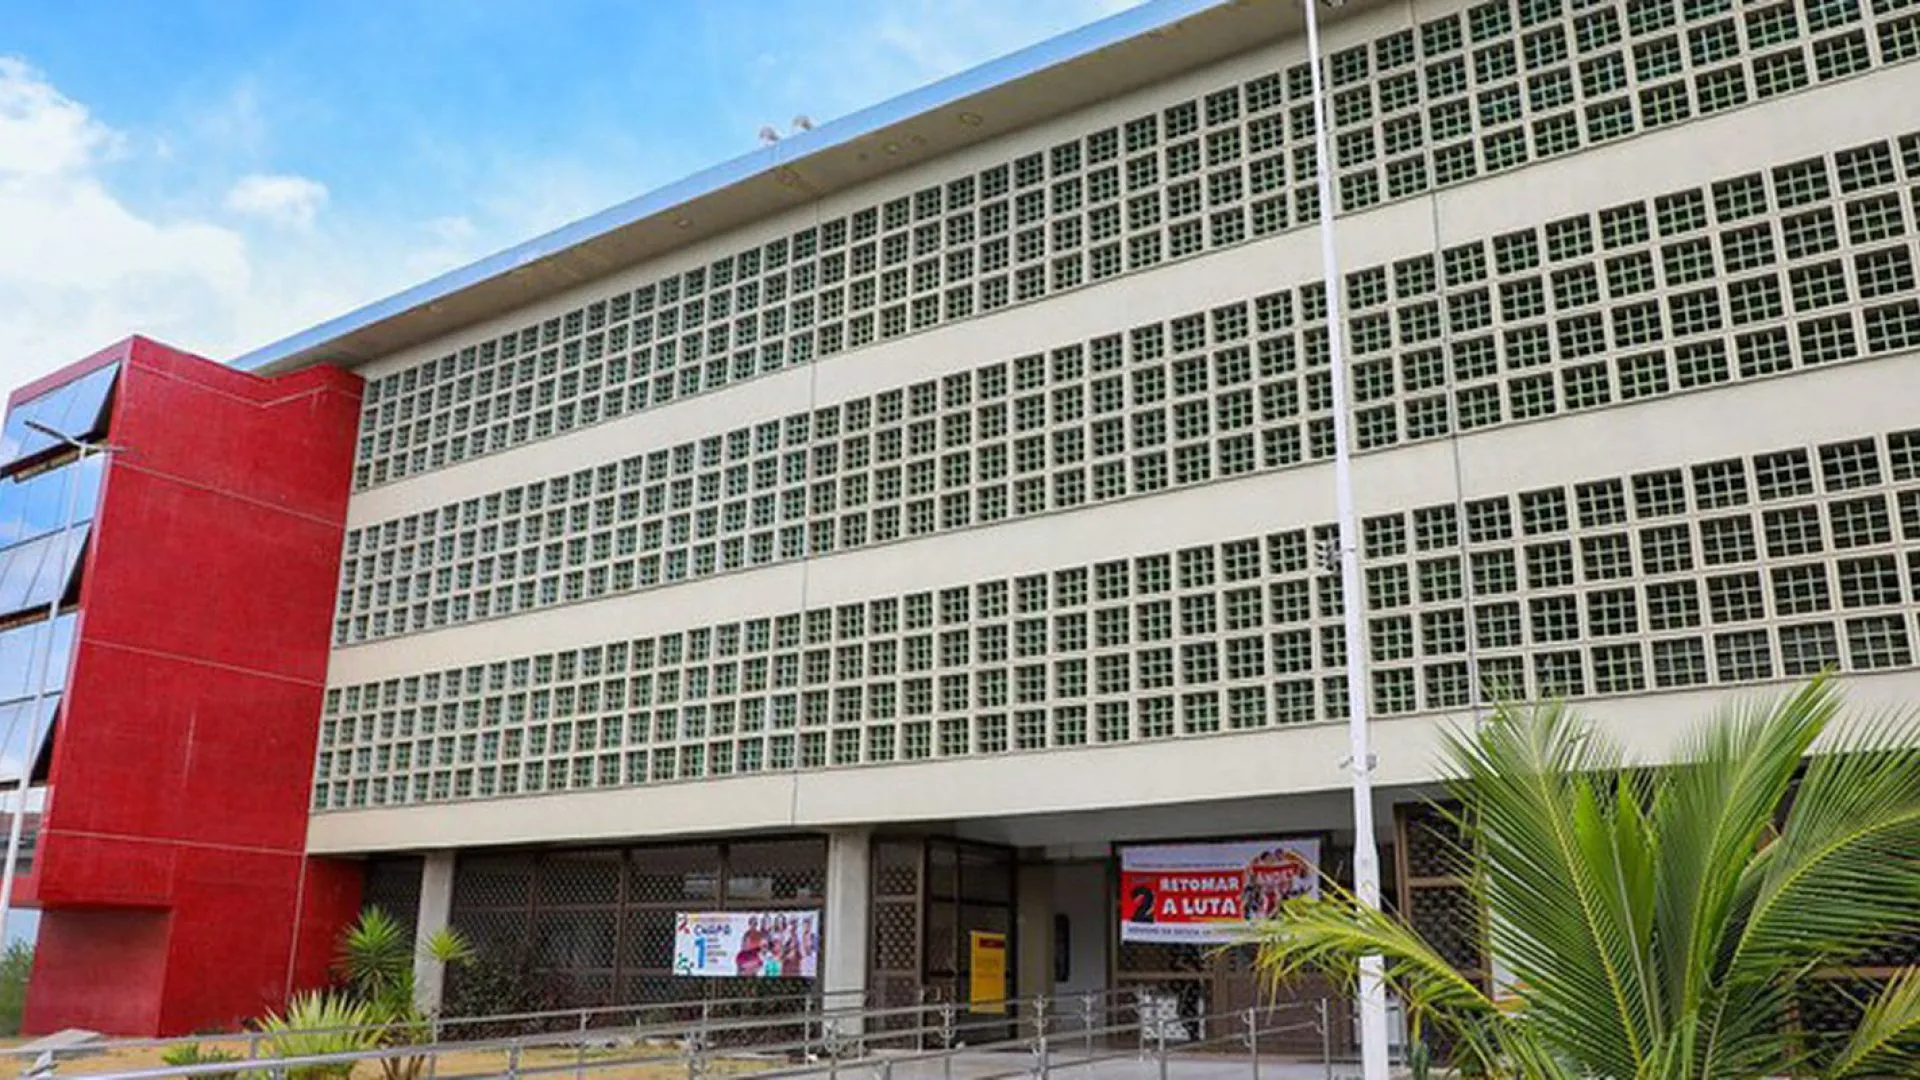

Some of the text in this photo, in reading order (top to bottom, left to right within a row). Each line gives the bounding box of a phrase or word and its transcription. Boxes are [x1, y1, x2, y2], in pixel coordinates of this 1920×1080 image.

[1161, 877, 1240, 892] RETOMAR
[1132, 888, 1154, 922] 2
[1162, 898, 1236, 915] A LUTA
[695, 937, 707, 968] 1
